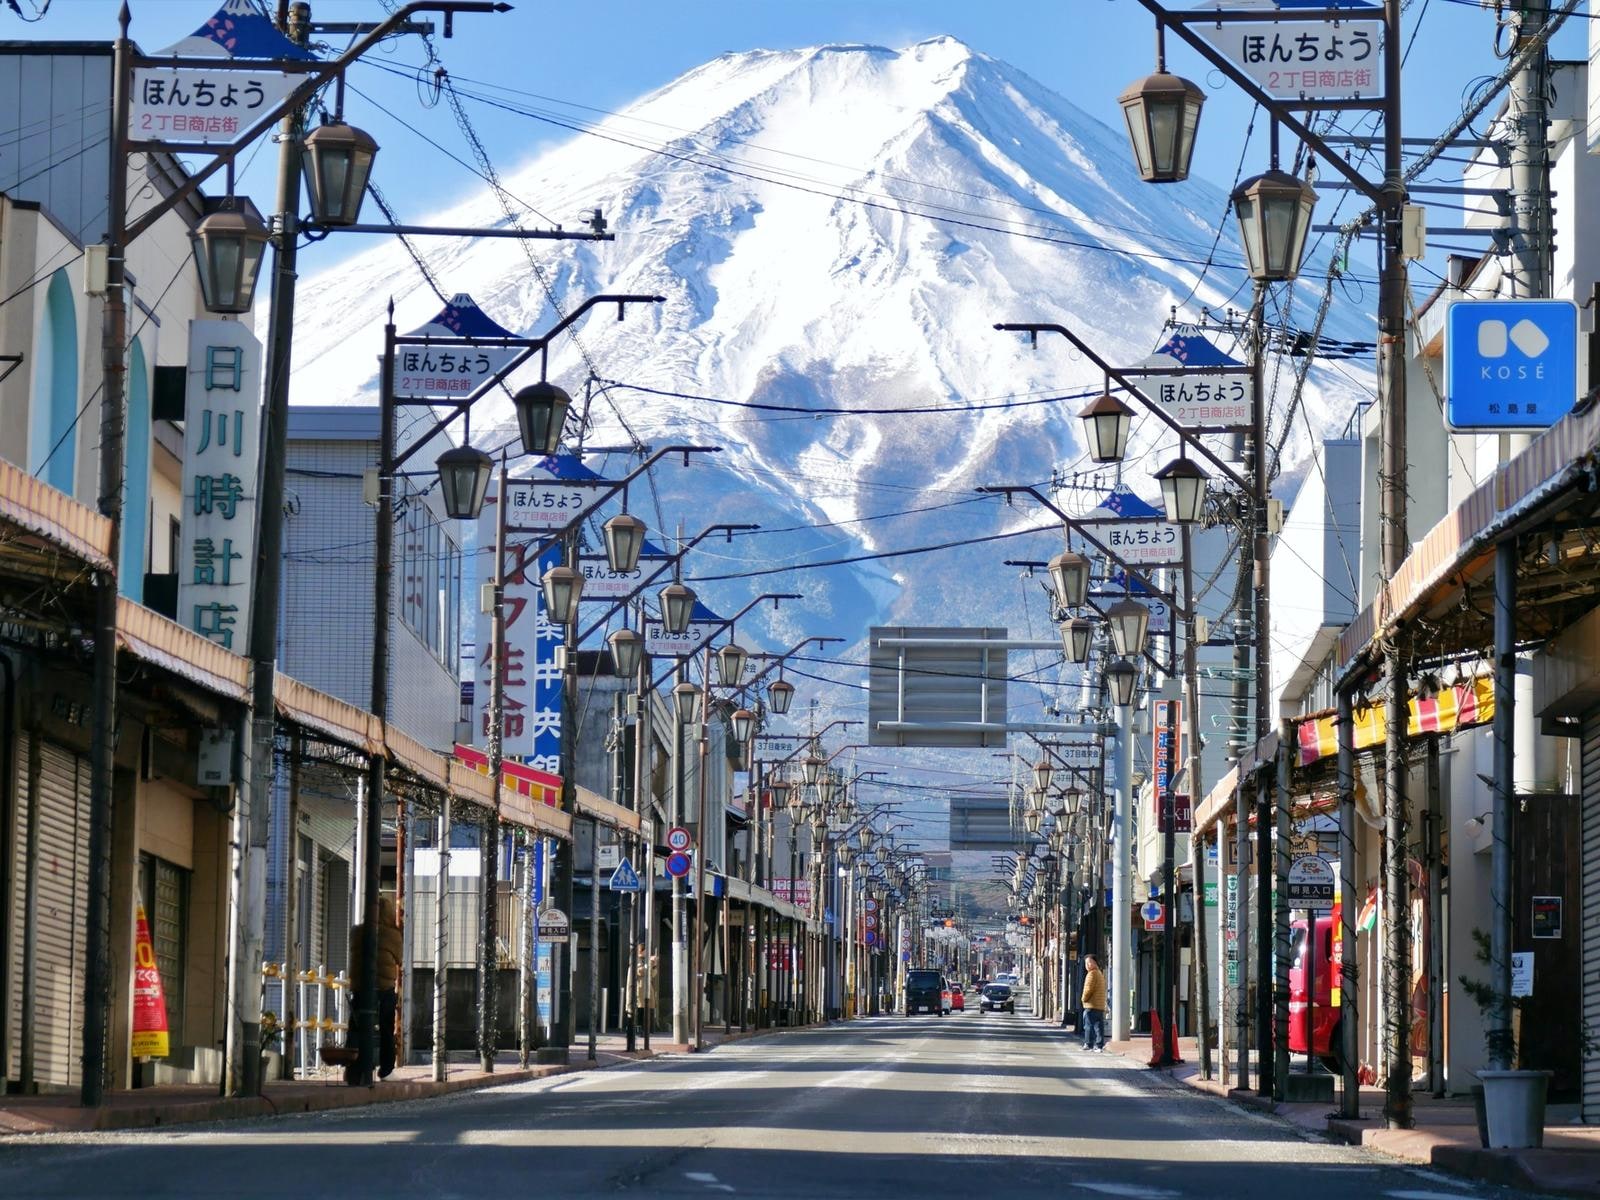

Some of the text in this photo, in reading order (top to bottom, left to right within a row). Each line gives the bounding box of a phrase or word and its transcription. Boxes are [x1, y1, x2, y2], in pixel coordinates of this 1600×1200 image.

[1242, 30, 1372, 63] ほんちょう
[1268, 68, 1372, 89] 2丁目商店街
[143, 78, 264, 109] ほんちょう
[141, 113, 239, 133] 2丁目商店街
[403, 352, 490, 375] ほんちょう
[1481, 362, 1544, 380] KOSÉ
[402, 377, 472, 391] 2丁目商店街
[1160, 381, 1245, 402] ほんちょう
[1178, 405, 1245, 419] 2丁目商店街
[193, 345, 244, 650] 日川時計店
[513, 491, 583, 509] ほんちょう
[1109, 528, 1175, 546] ほんちょう
[672, 834, 685, 845] 40
[1291, 886, 1331, 895] 明見入口
